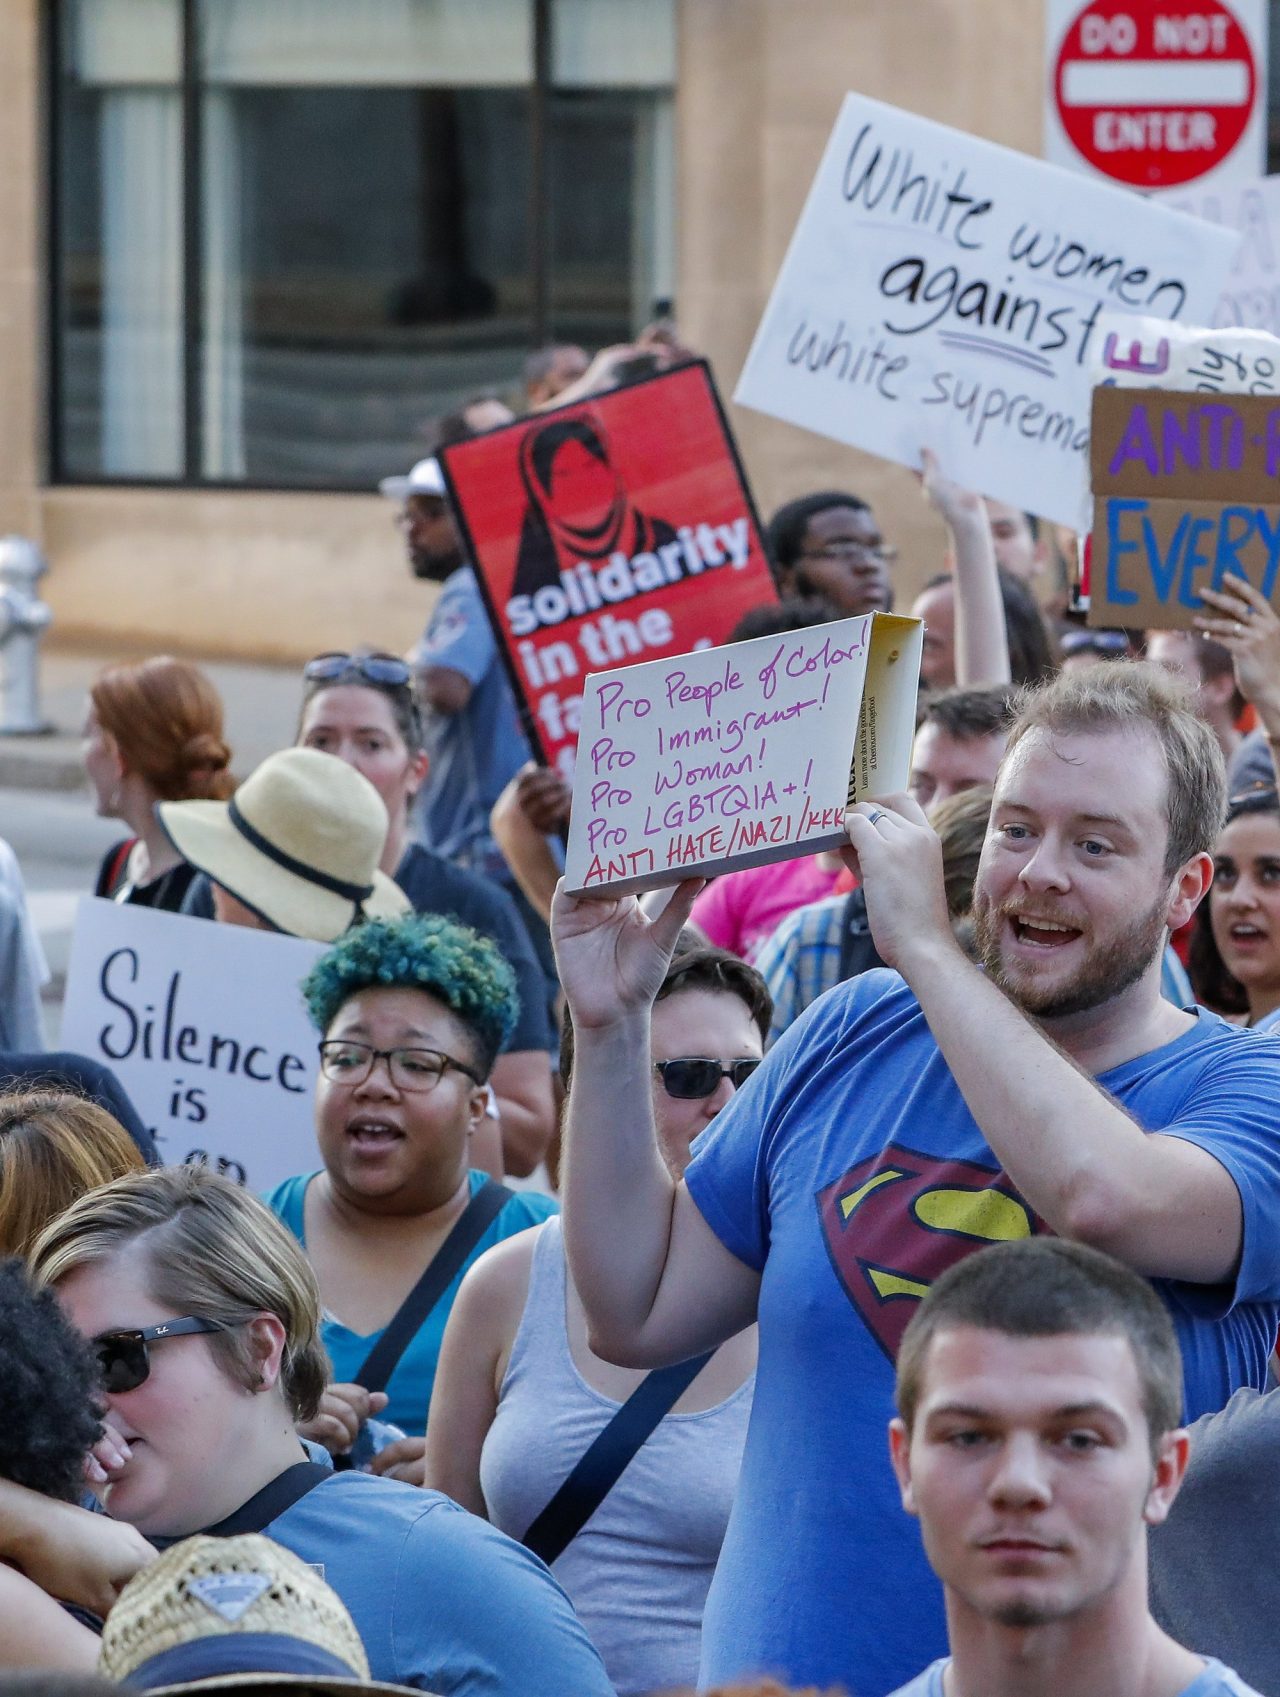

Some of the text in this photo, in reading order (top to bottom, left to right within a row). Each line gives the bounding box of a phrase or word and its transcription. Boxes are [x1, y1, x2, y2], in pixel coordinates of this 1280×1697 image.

[1080, 13, 1229, 54] DO NOT
[1092, 111, 1217, 152] ENTER
[842, 123, 1187, 320] White women
[880, 256, 1104, 365] against
[786, 320, 909, 401] white
[505, 517, 750, 636] solidarity
[517, 607, 673, 689] in the
[597, 619, 868, 729] Pro People of Color!
[591, 738, 636, 775] Pro
[657, 673, 831, 755] Immigrant!
[591, 738, 766, 812] Pro Woman!
[583, 848, 654, 888] ANTI
[587, 818, 628, 854] Pro
[99, 948, 306, 1094] Silence
[170, 1078, 208, 1123] is
